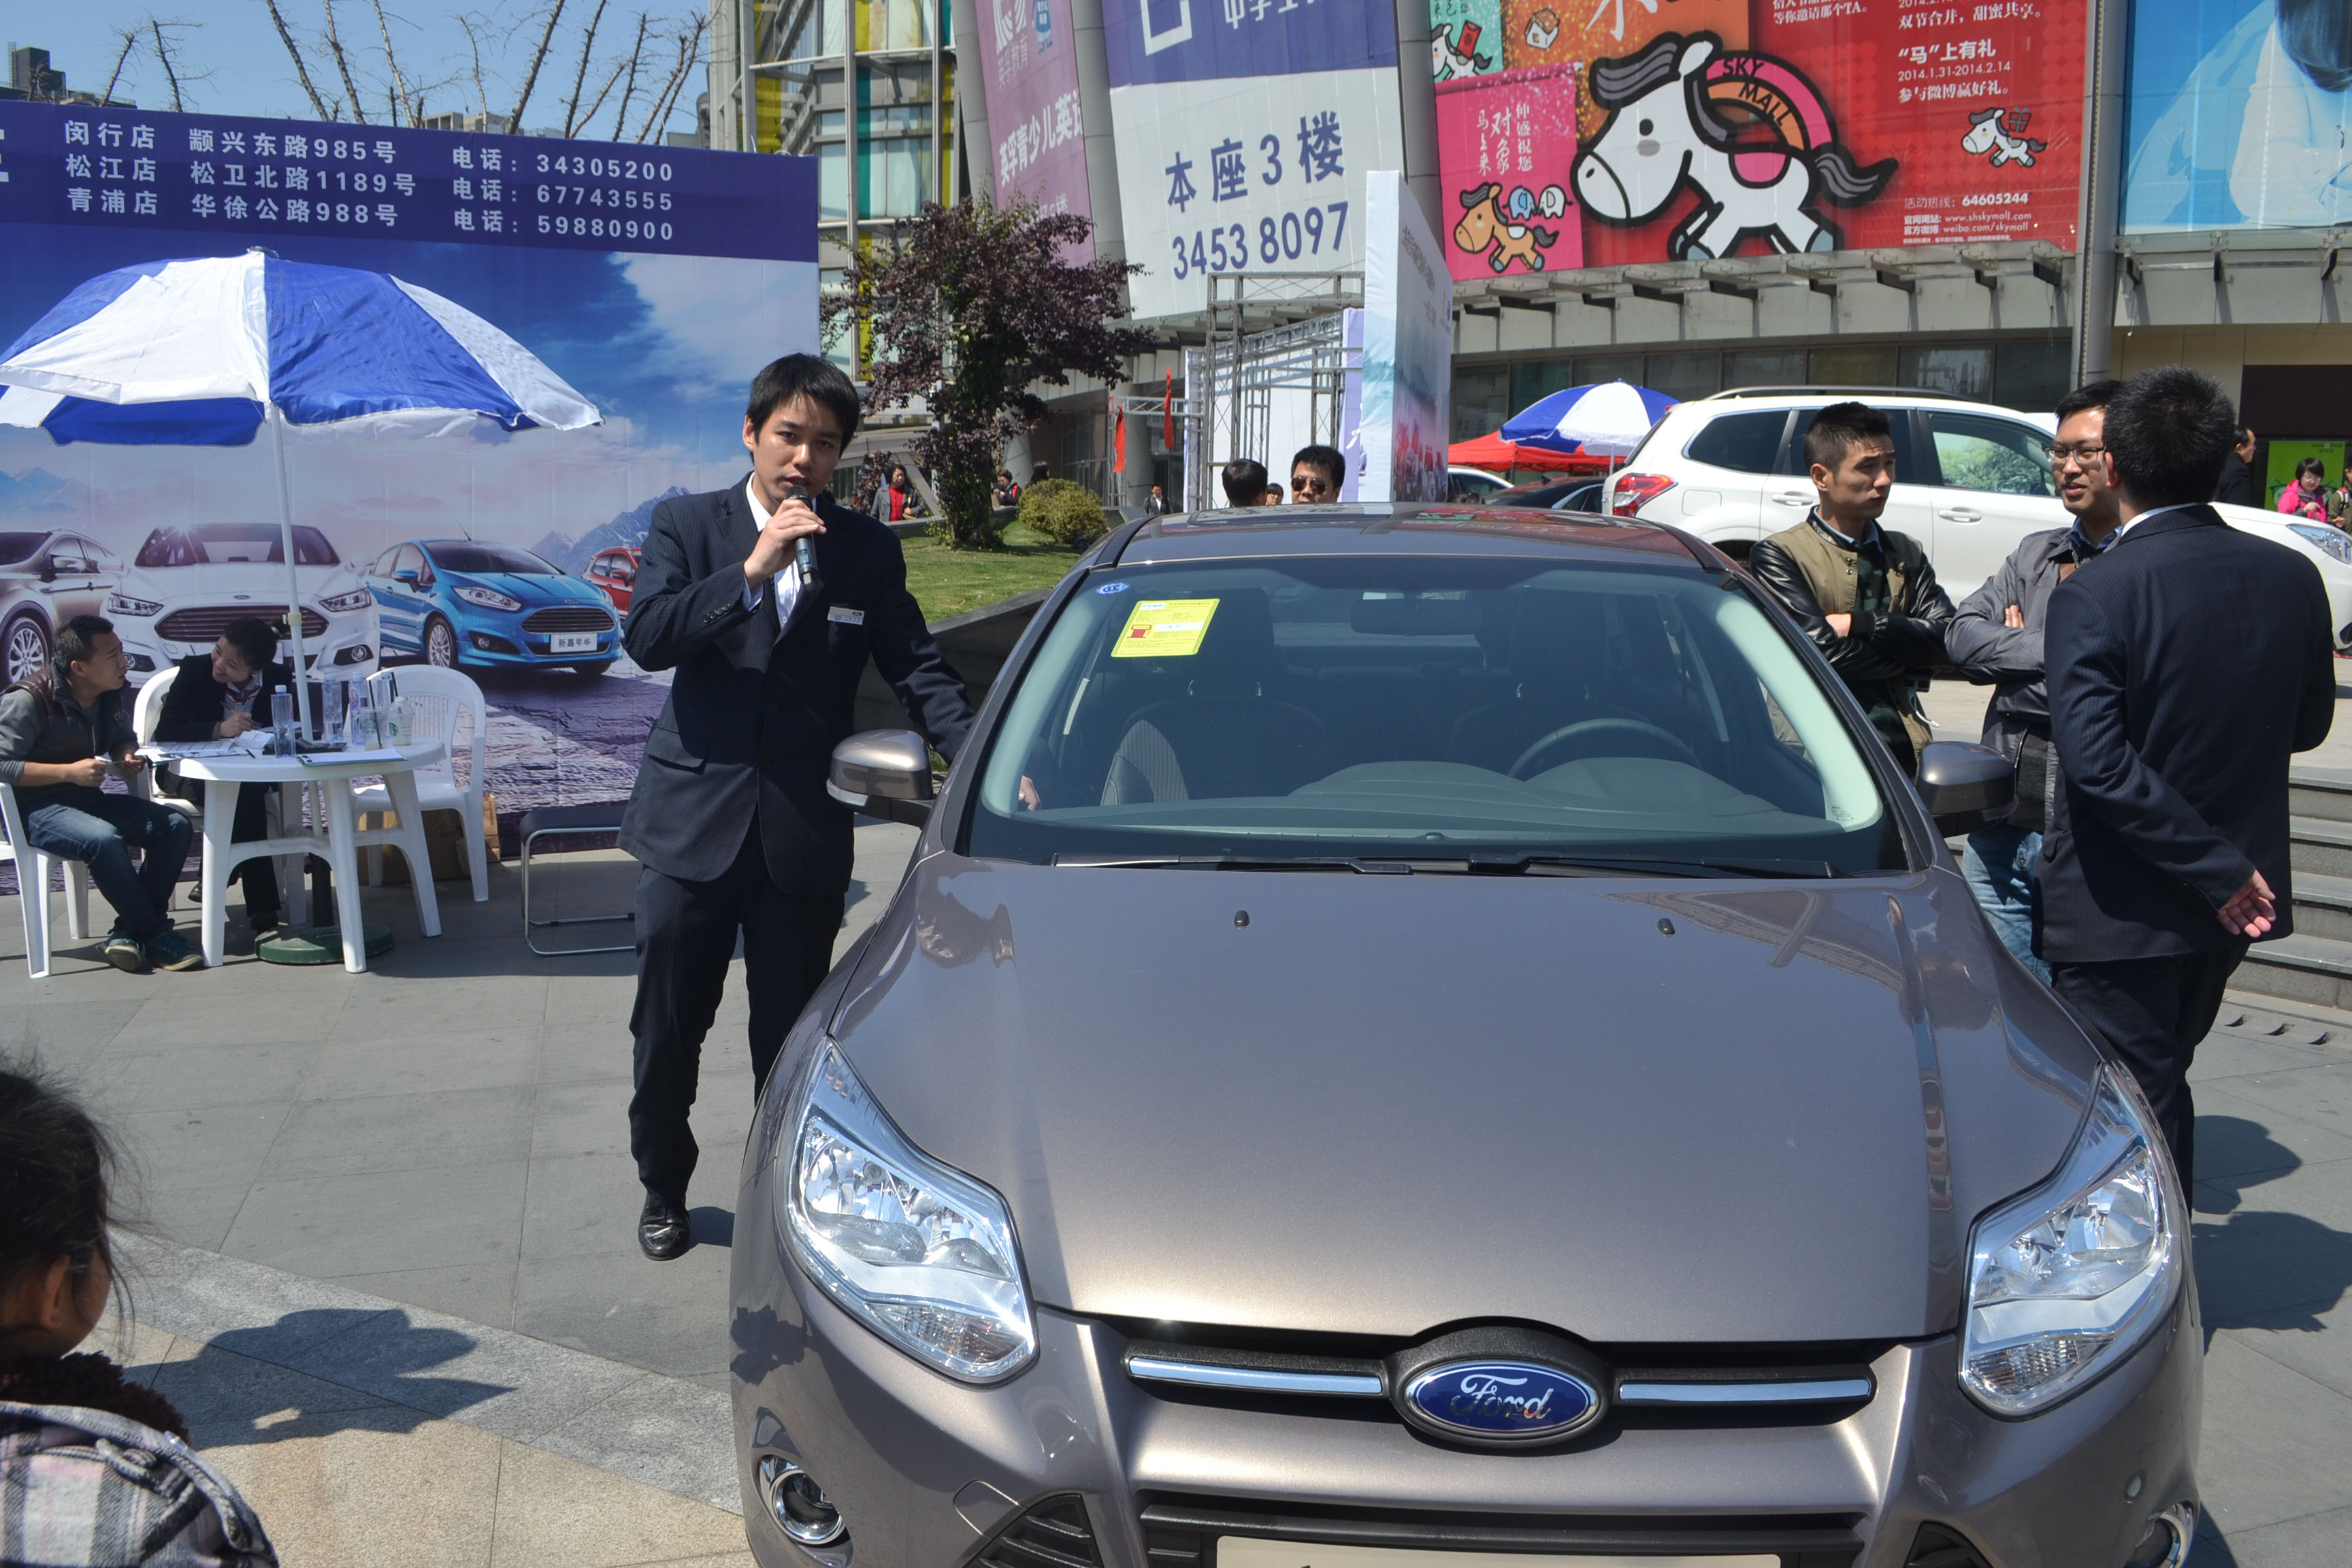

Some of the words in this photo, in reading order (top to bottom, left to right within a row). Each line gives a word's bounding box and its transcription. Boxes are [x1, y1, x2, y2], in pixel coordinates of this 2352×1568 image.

[1722, 57, 1765, 76] SKY
[1898, 61, 2011, 82] 2014.1.31-2014.2.14
[1738, 82, 1791, 127] MALL
[65, 120, 154, 149] 闵行店
[189, 128, 396, 163] 颛兴东路985号
[537, 154, 672, 181] 34305200
[1165, 110, 1345, 213] 本座3楼
[1490, 105, 1512, 175] 对象
[66, 153, 156, 182] 松江店
[191, 161, 416, 196] 松卫北路1189号
[537, 184, 672, 210] 67743555
[1962, 193, 2029, 206] 64605244
[67, 187, 157, 215] 青浦店
[192, 193, 397, 227] 华徐公路988号
[538, 215, 673, 240] 59880900
[1943, 222, 2028, 233] weibo.com/skymall
[1945, 210, 2031, 223] www.shskymall.com
[1172, 223, 1248, 280] 3453
[1260, 201, 1348, 263] 8097
[559, 638, 591, 648] 新嘉年华
[1450, 1374, 1554, 1420] Ford
